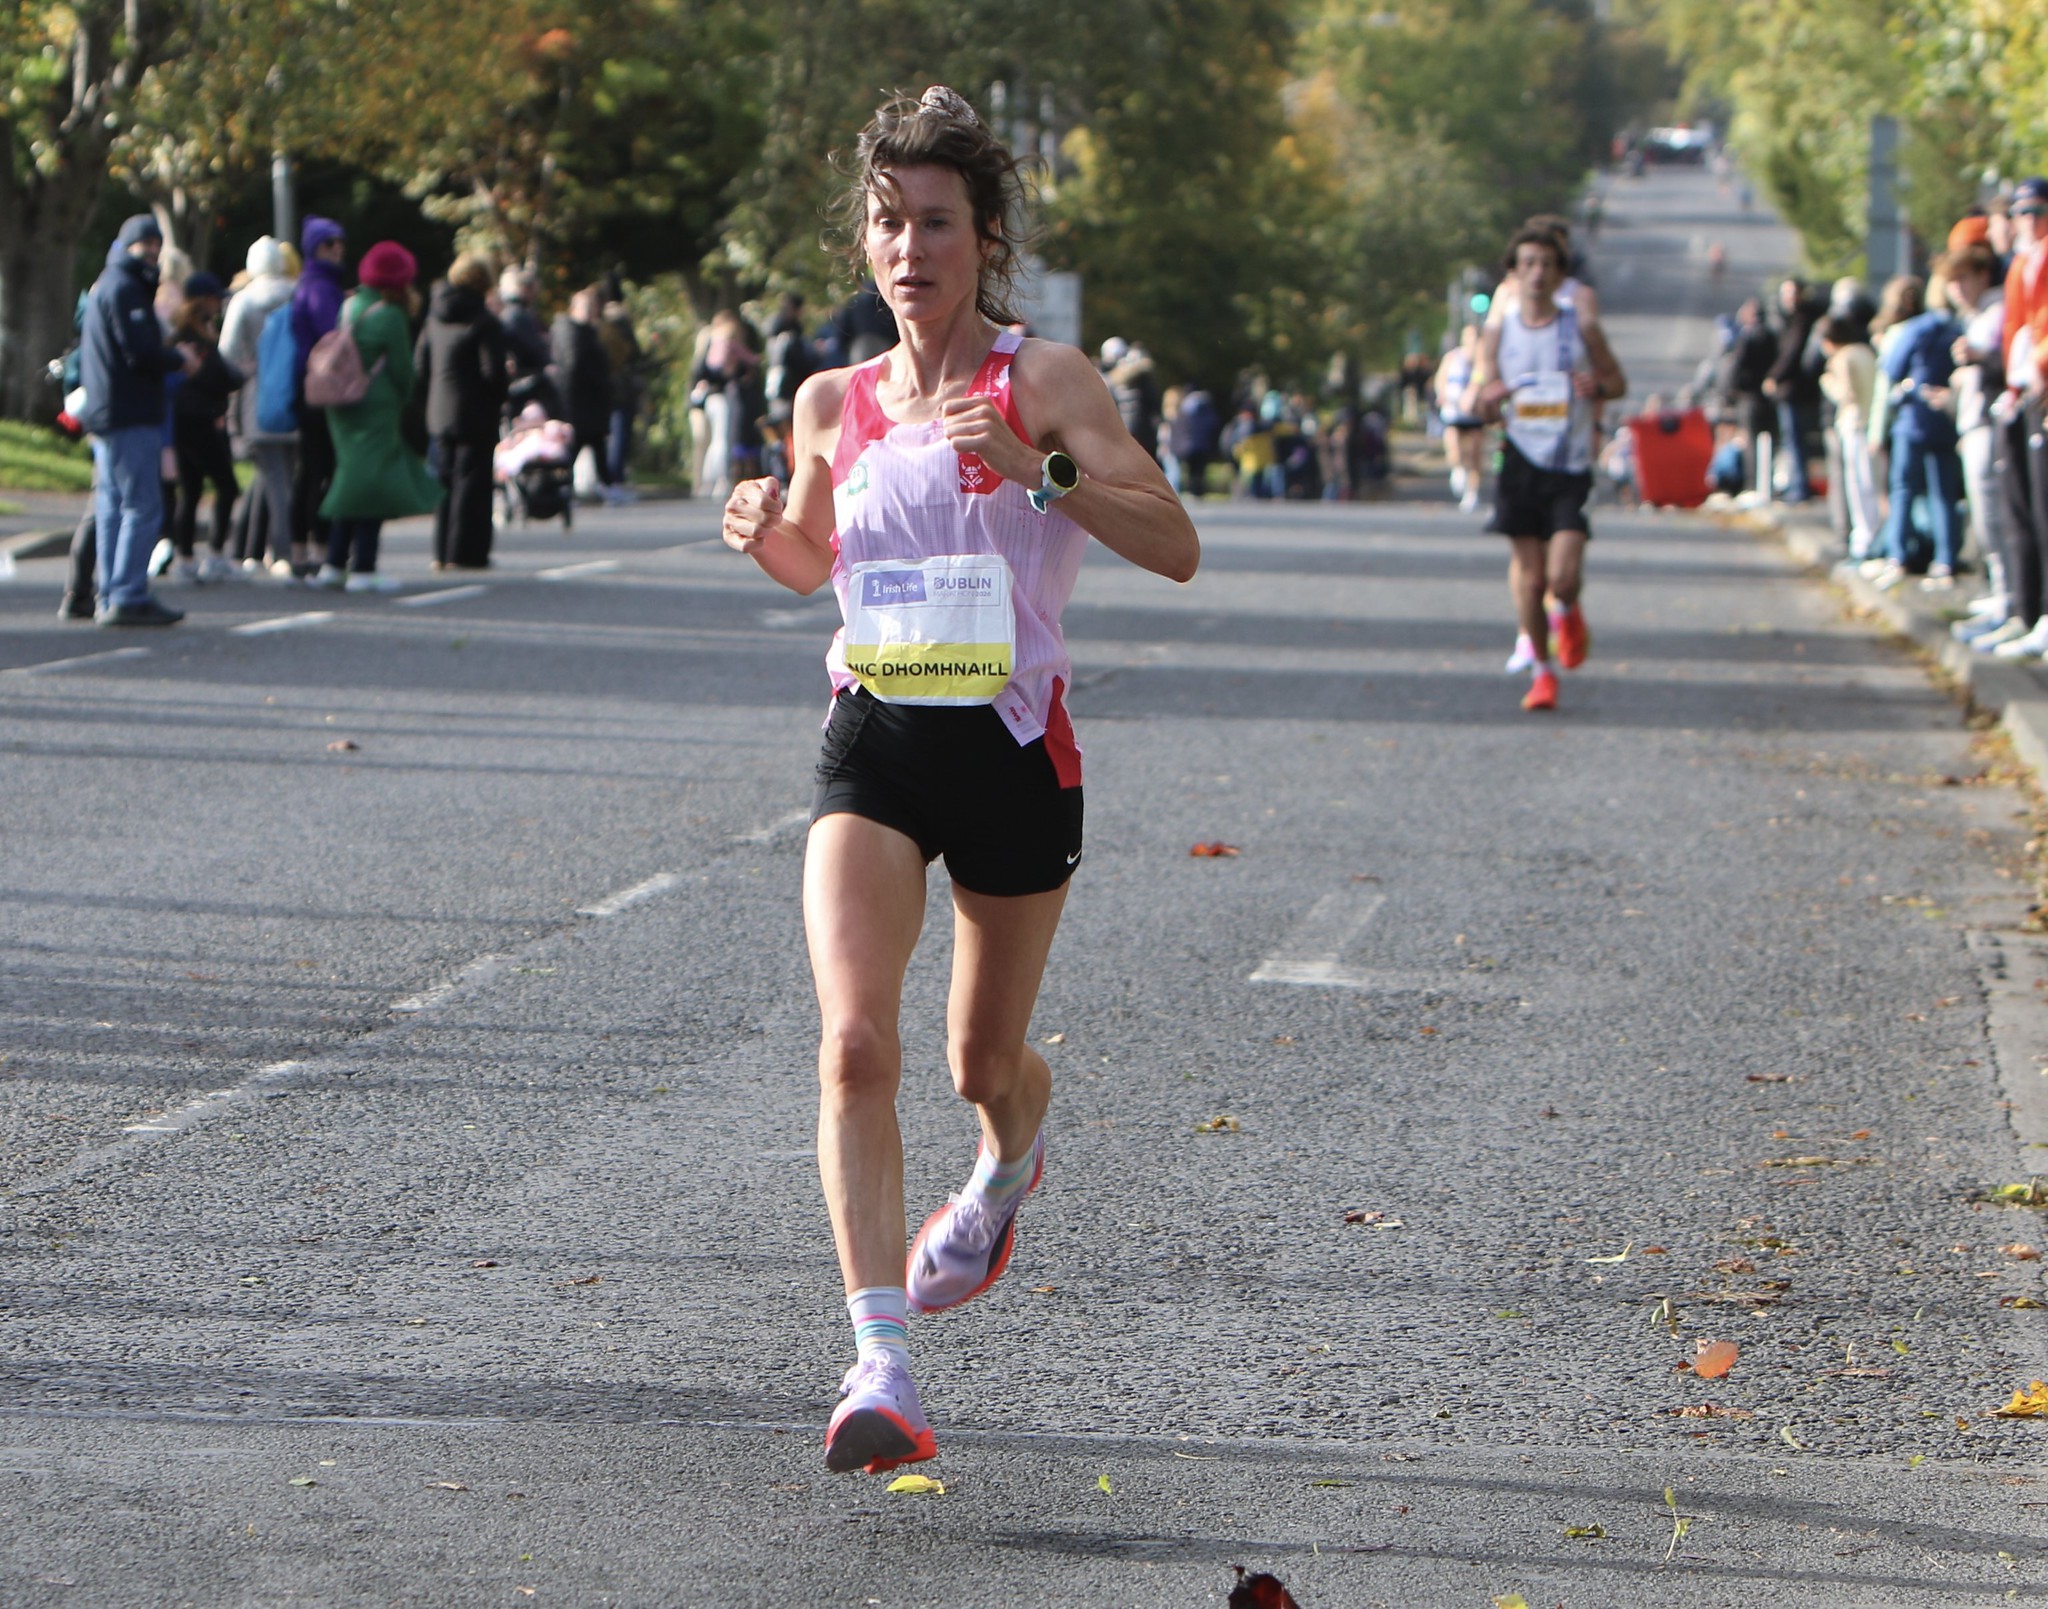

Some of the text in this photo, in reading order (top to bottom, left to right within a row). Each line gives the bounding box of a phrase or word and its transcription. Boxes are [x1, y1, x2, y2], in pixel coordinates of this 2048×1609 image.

[882, 583, 918, 594] Irish Life
[933, 577, 991, 589] DUBLIN
[882, 662, 1008, 677] DHOMHNAILL
